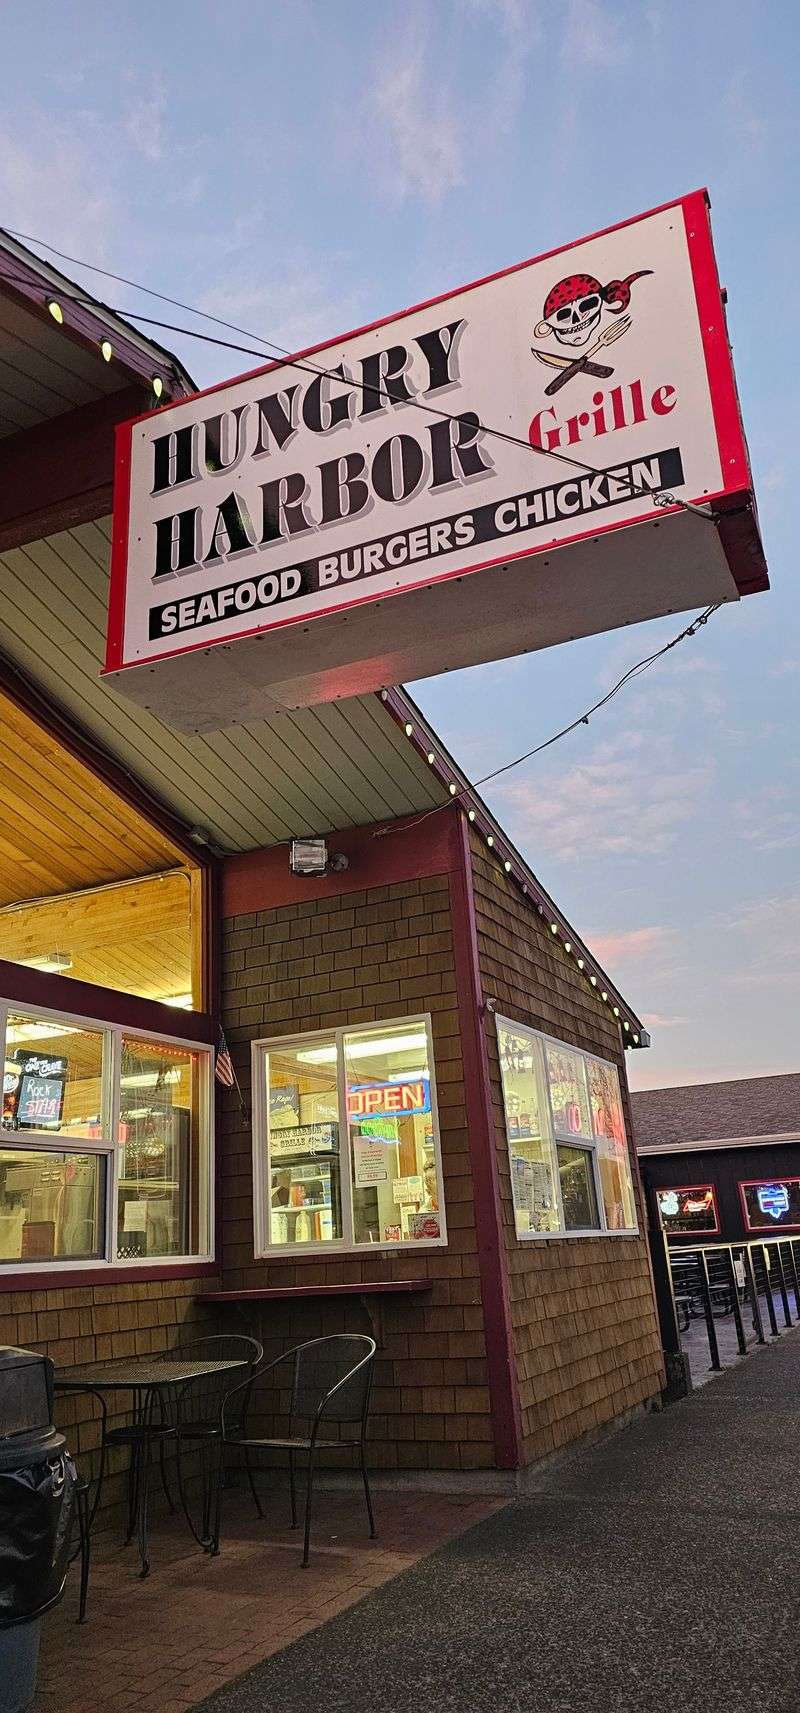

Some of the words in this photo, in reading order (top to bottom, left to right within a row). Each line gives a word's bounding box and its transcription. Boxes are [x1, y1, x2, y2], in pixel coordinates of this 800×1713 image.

[150, 318, 467, 497] HUNGRY
[528, 379, 678, 453] Grille
[150, 411, 497, 584] HARBOR
[161, 569, 302, 633] SEAFOOD
[318, 515, 475, 587] BURGERS
[494, 458, 662, 533] CHICKEN
[347, 1083, 423, 1115] OPEN
